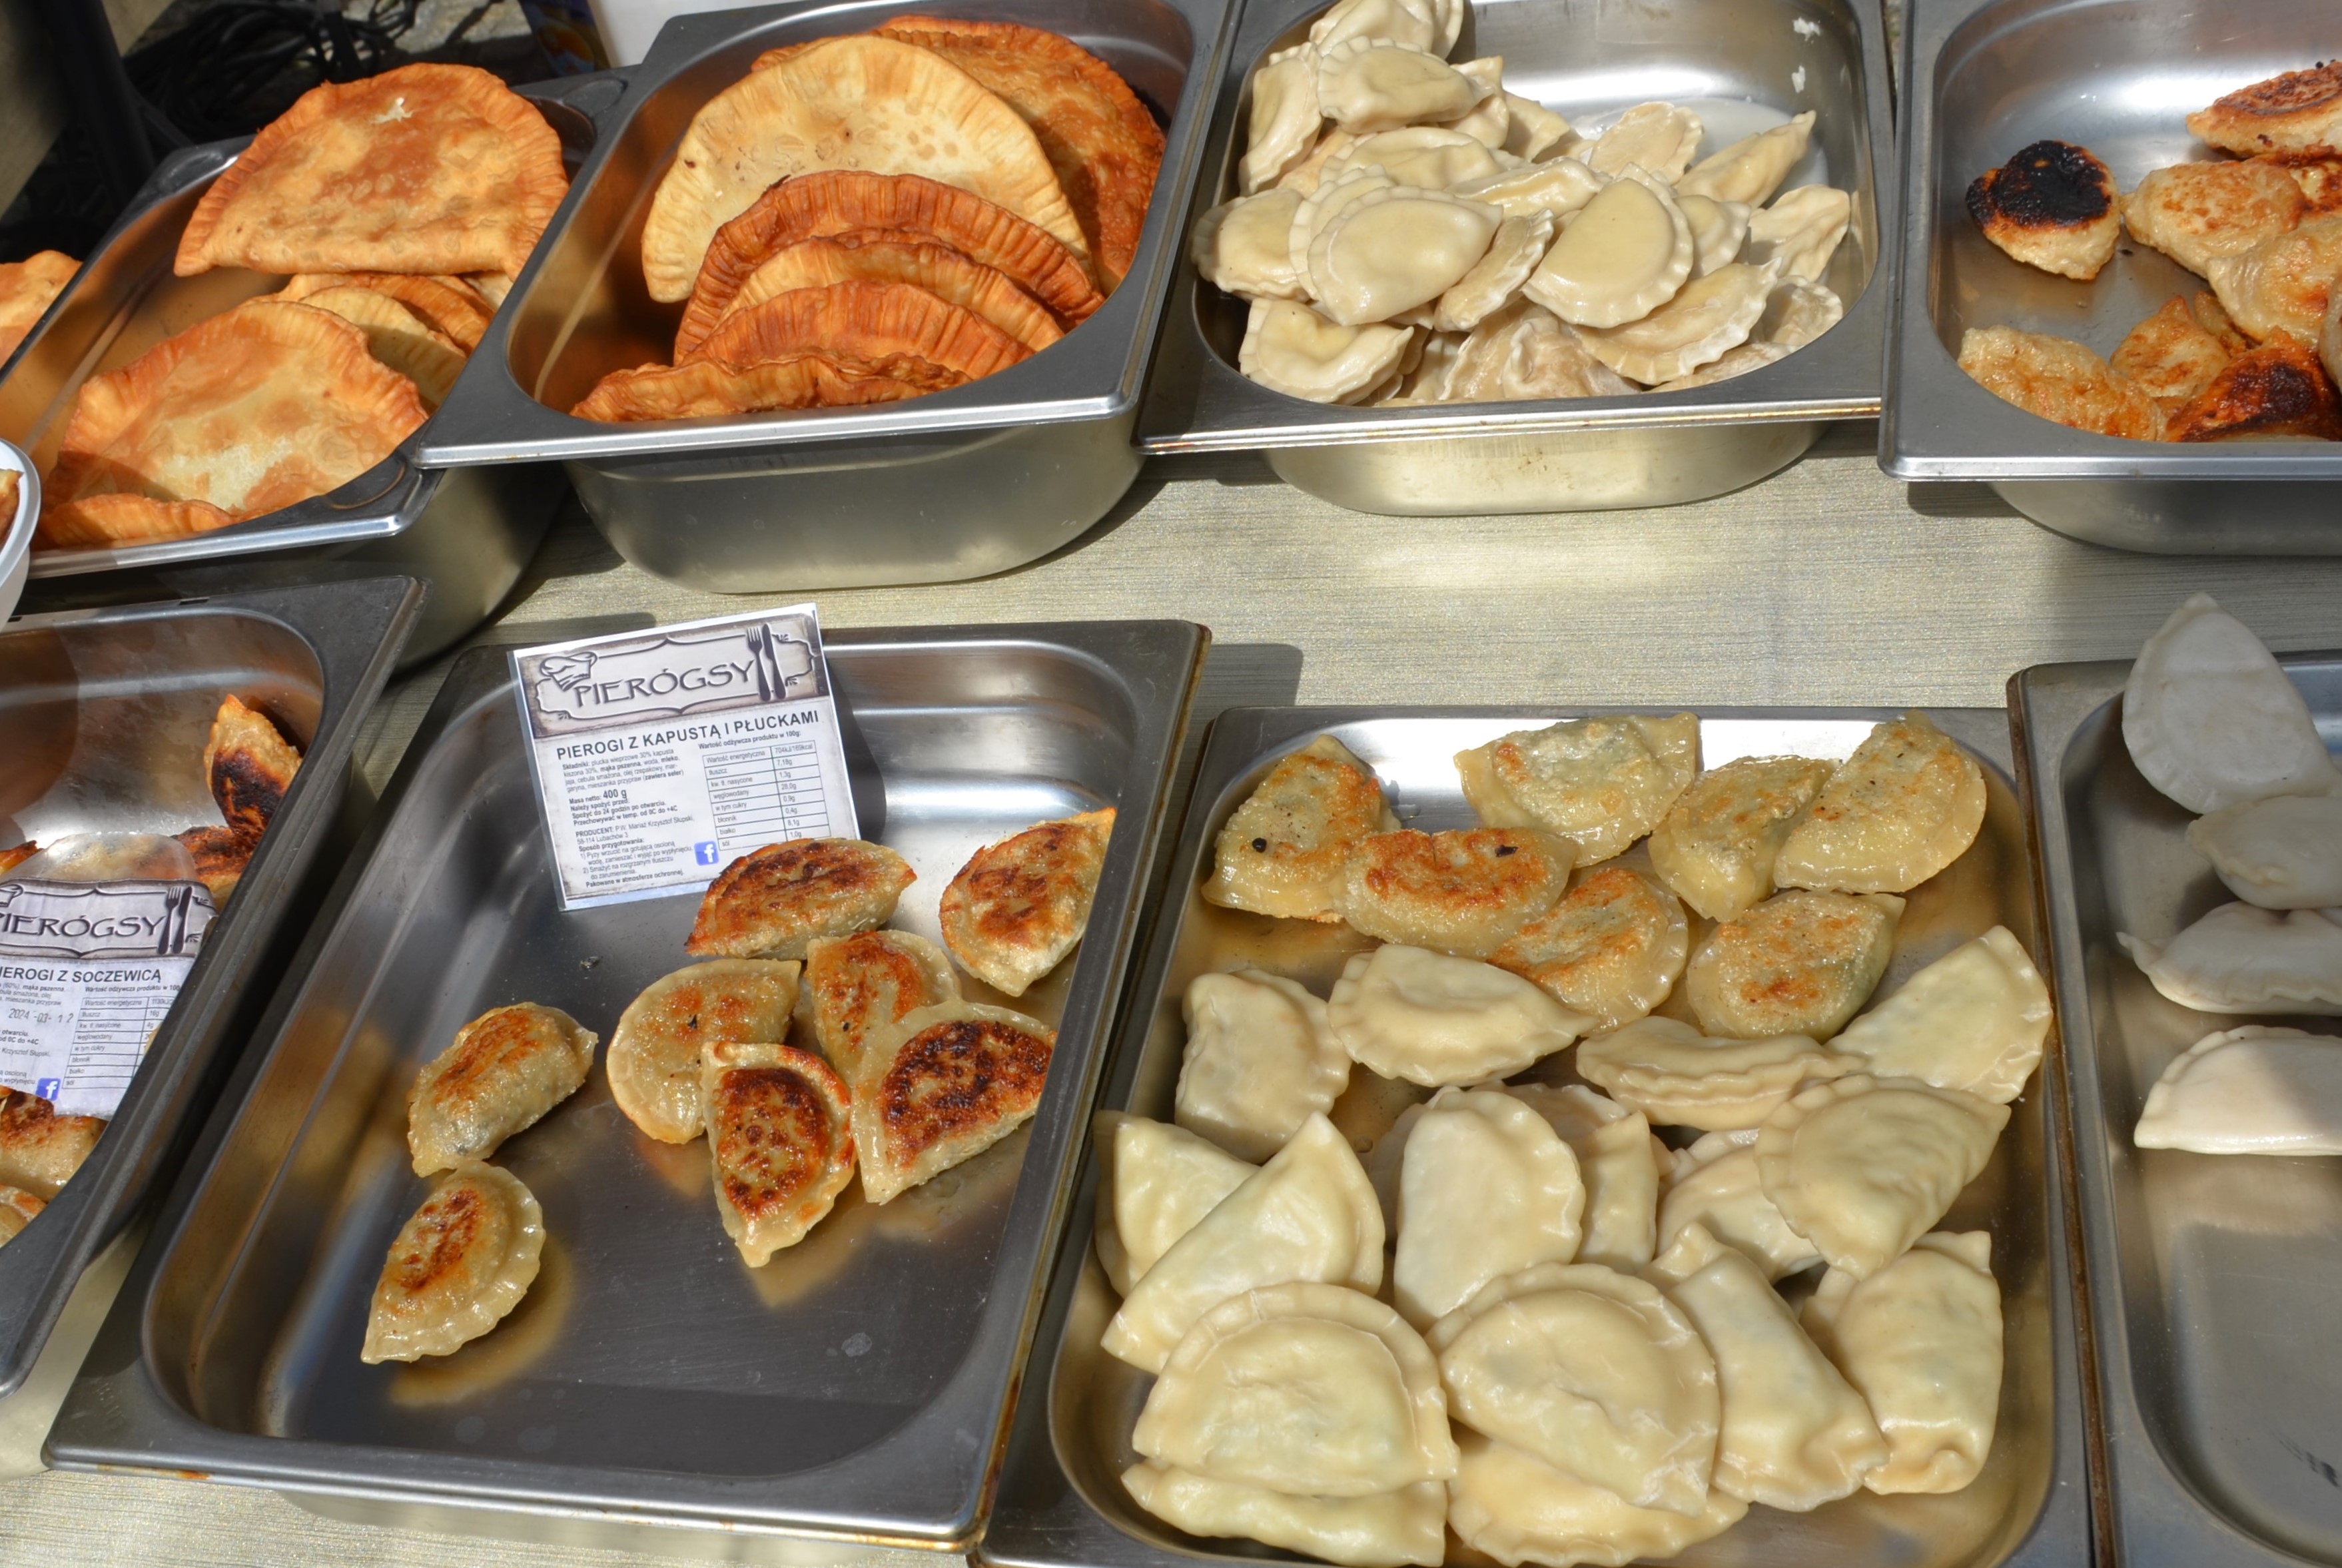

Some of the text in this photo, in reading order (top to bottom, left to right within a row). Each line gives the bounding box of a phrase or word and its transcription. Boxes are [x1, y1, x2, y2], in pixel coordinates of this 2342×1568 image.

[574, 659, 755, 707] PIERÓGSY
[557, 710, 819, 760] PIEROGI Z KAPUSTĄ I PŁUCKAMI
[723, 737, 751, 746] odżywcza
[753, 733, 778, 743] produktu
[653, 749, 674, 757] kapusta
[729, 750, 765, 761] energetyczna
[617, 776, 641, 786] przypraw
[603, 789, 618, 799] 400
[621, 790, 627, 799] g
[571, 803, 589, 812] Należy
[590, 801, 610, 809] spożyć
[611, 805, 630, 813] godzin
[574, 815, 615, 826] Przechowywać
[648, 818, 672, 827] Krzysztof
[622, 873, 653, 883] atmosferze
[0, 967, 161, 982] IEROGI Z SOCZEWICĄ
[9, 1008, 30, 1019] 2024
